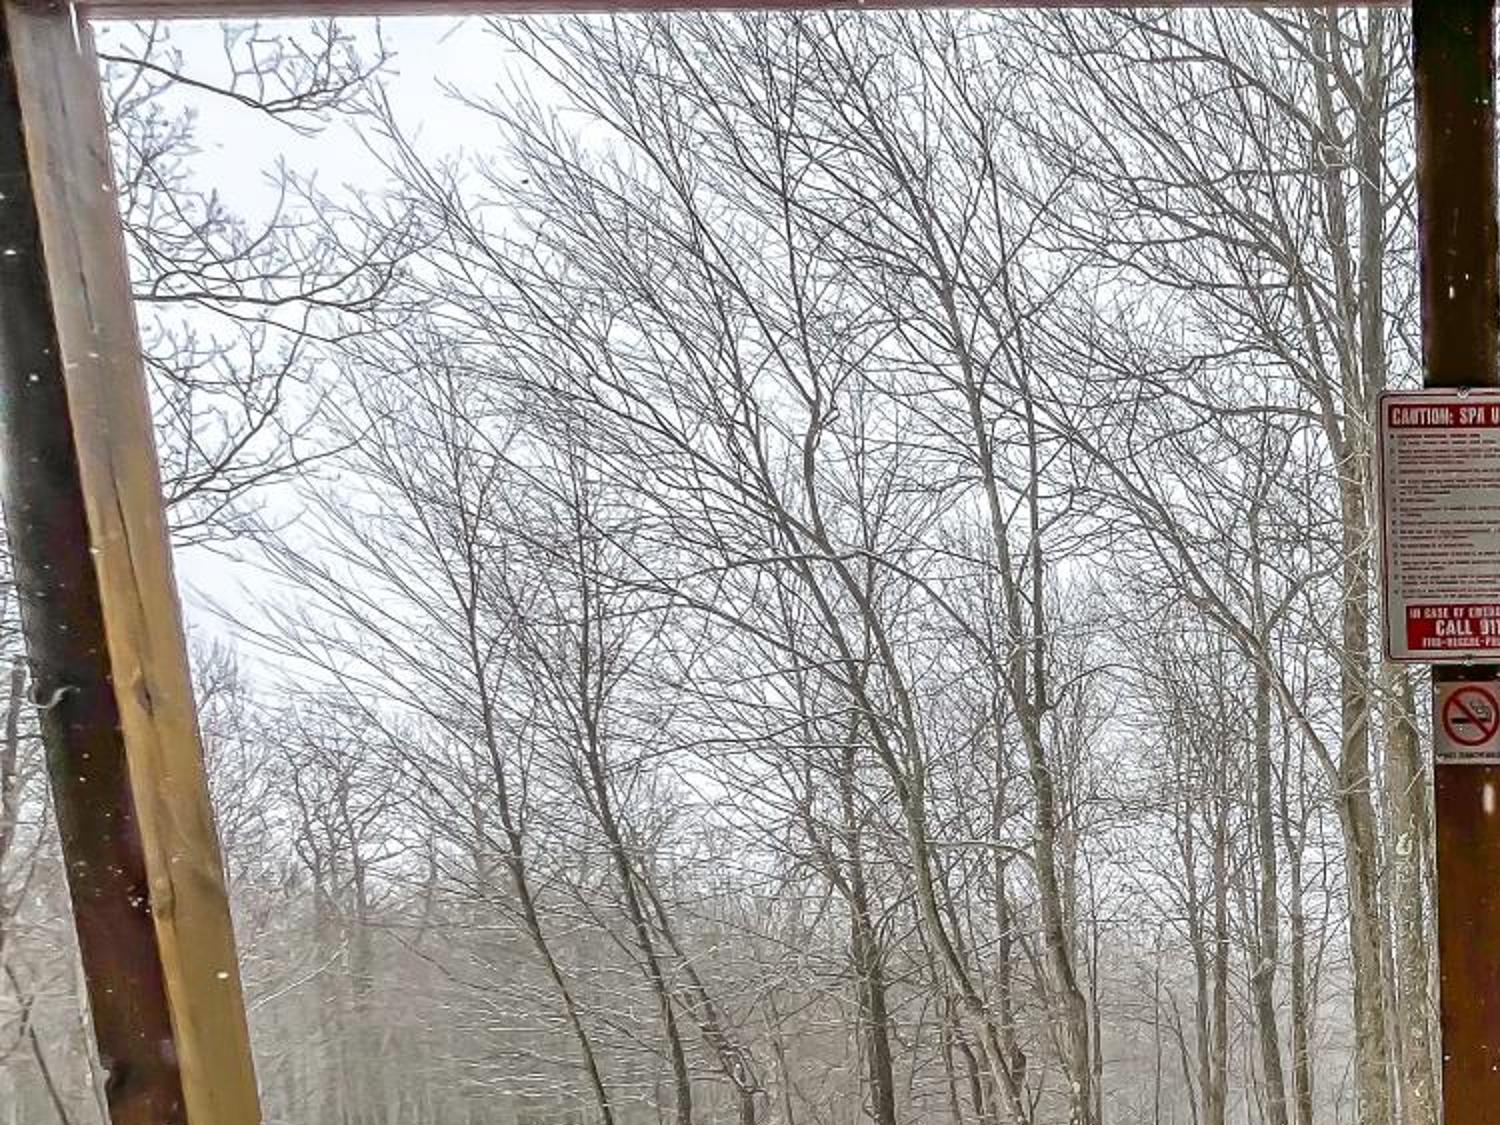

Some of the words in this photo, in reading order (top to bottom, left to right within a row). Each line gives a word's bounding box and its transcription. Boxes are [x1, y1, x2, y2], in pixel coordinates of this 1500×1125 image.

[1391, 406, 1454, 425] CAUTION:
[1459, 406, 1486, 424] SPA
[1435, 619, 1473, 636] CALL
